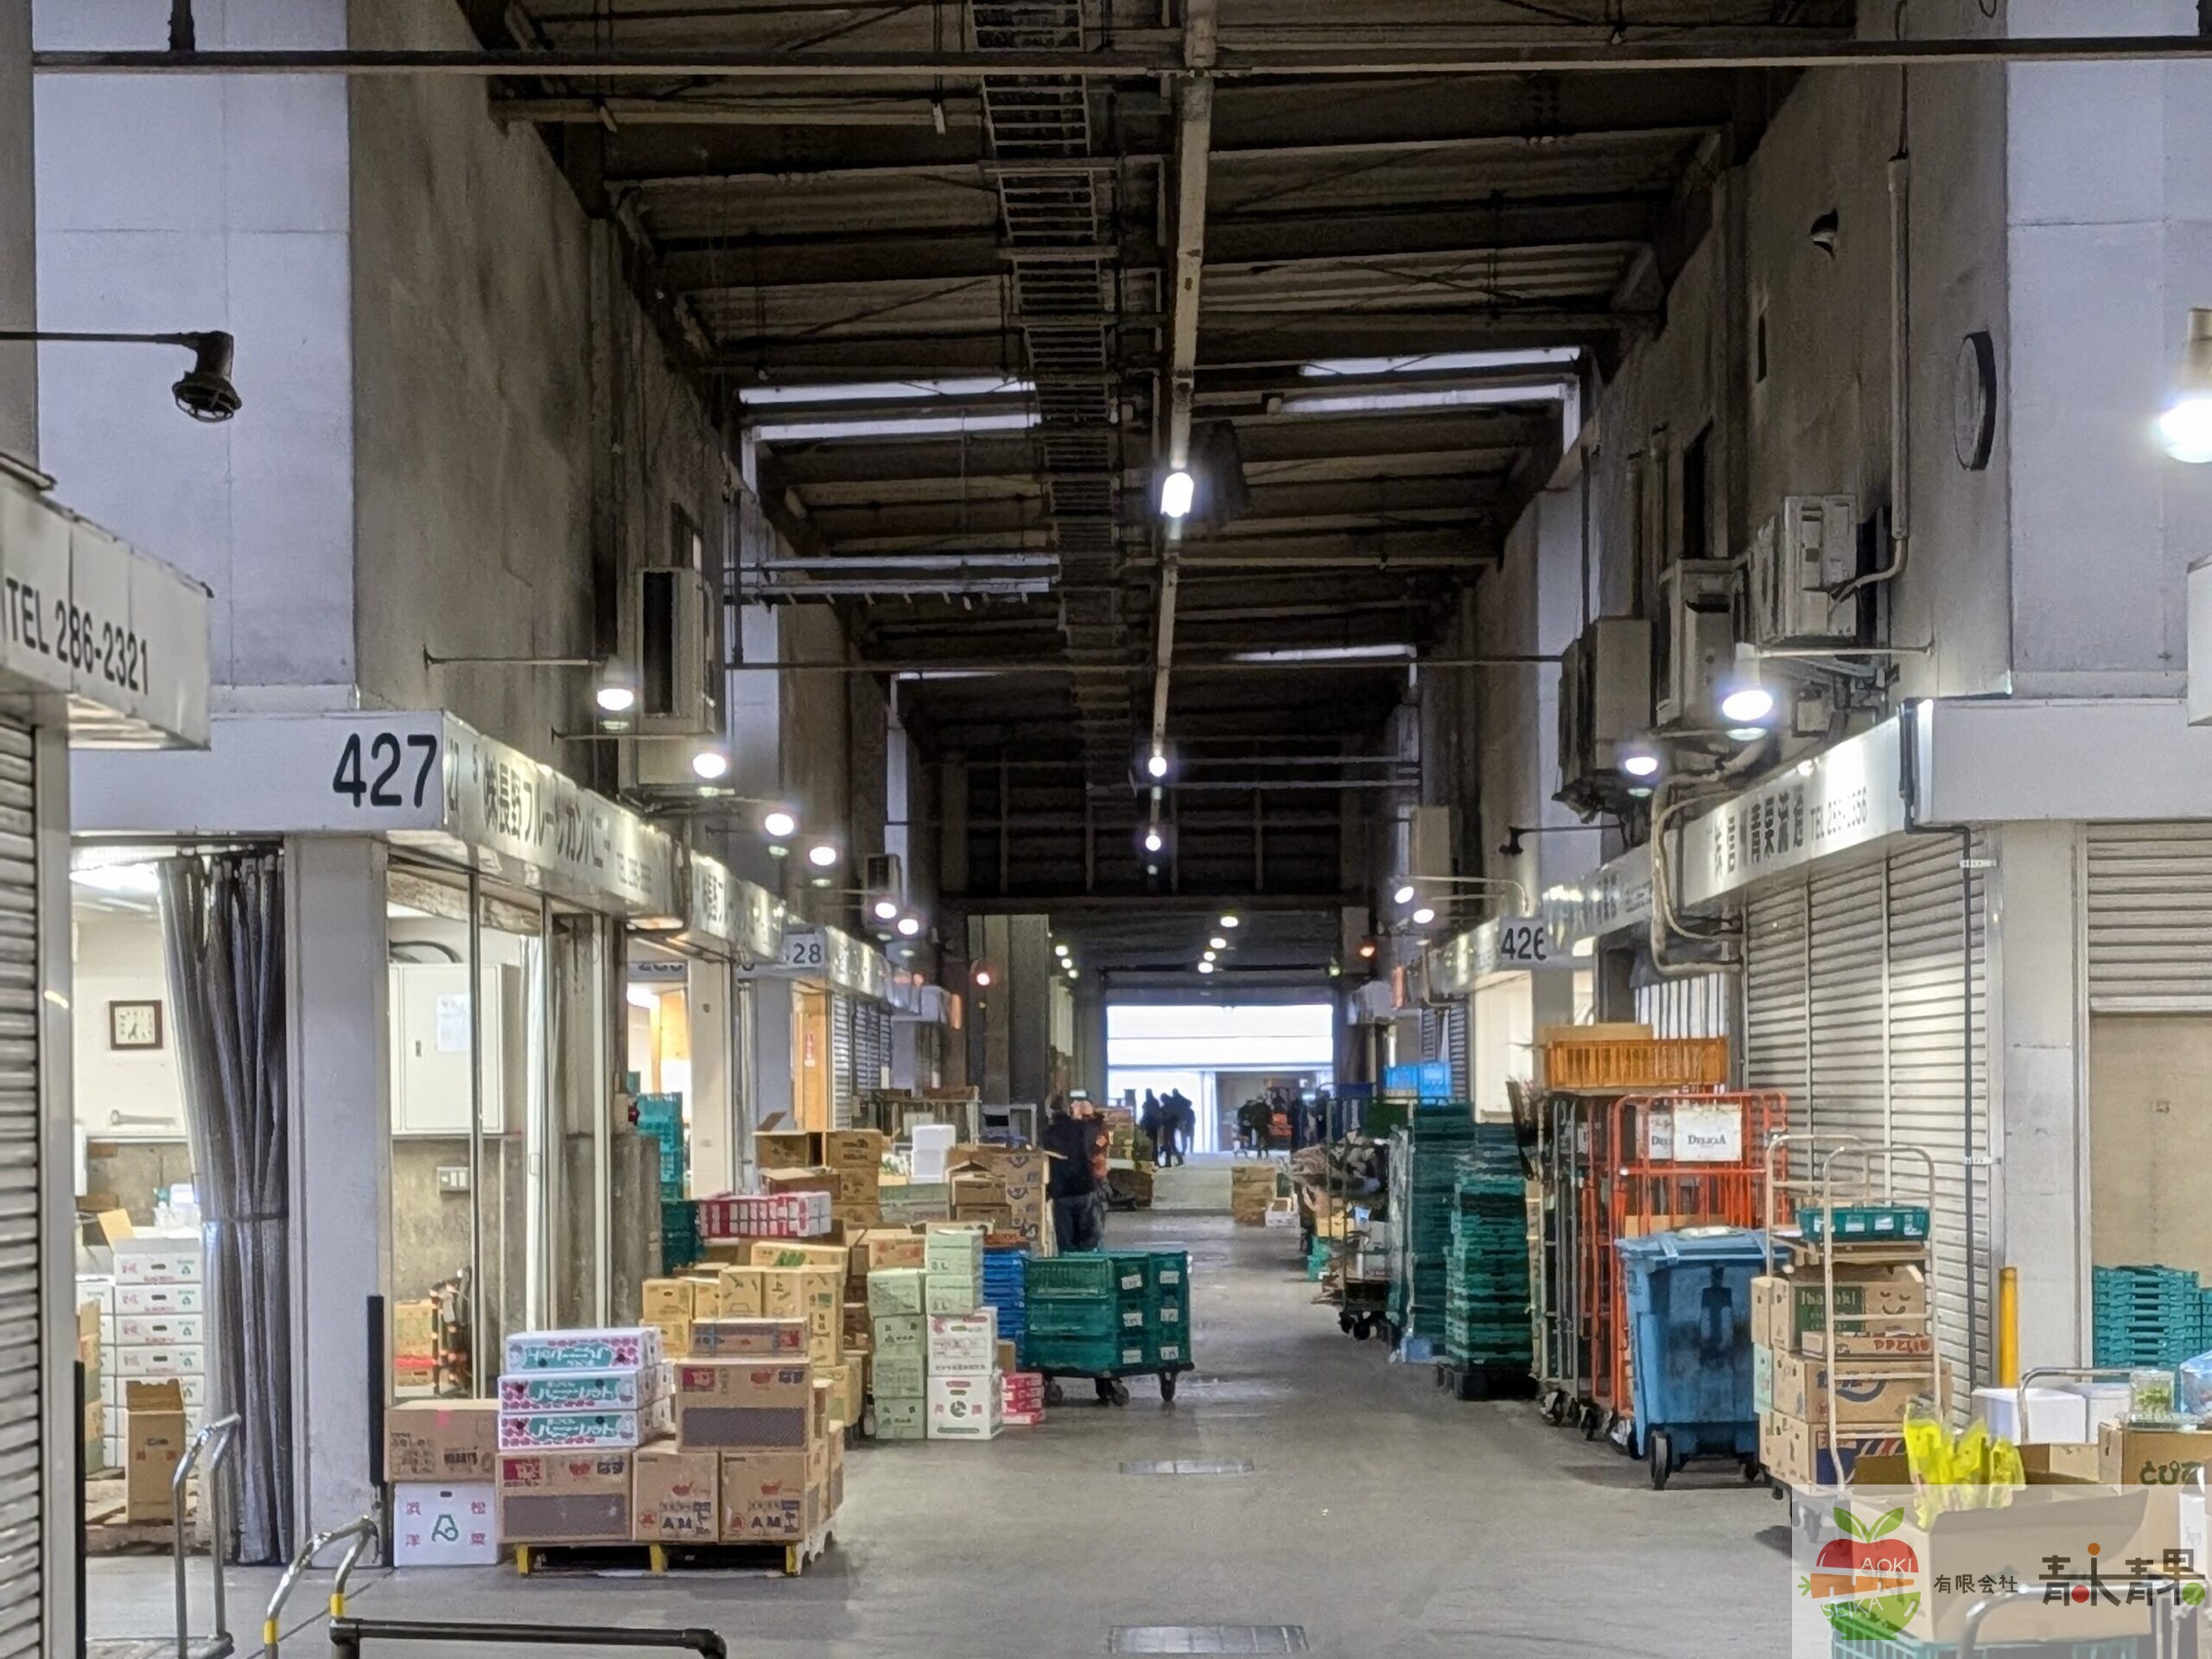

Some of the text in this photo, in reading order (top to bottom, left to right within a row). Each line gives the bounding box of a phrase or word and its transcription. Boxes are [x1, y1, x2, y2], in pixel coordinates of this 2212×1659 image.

[6, 577, 149, 696] TEL 286-2321
[333, 732, 437, 808] 427
[786, 942, 822, 964] 28
[1502, 926, 1548, 961] 426
